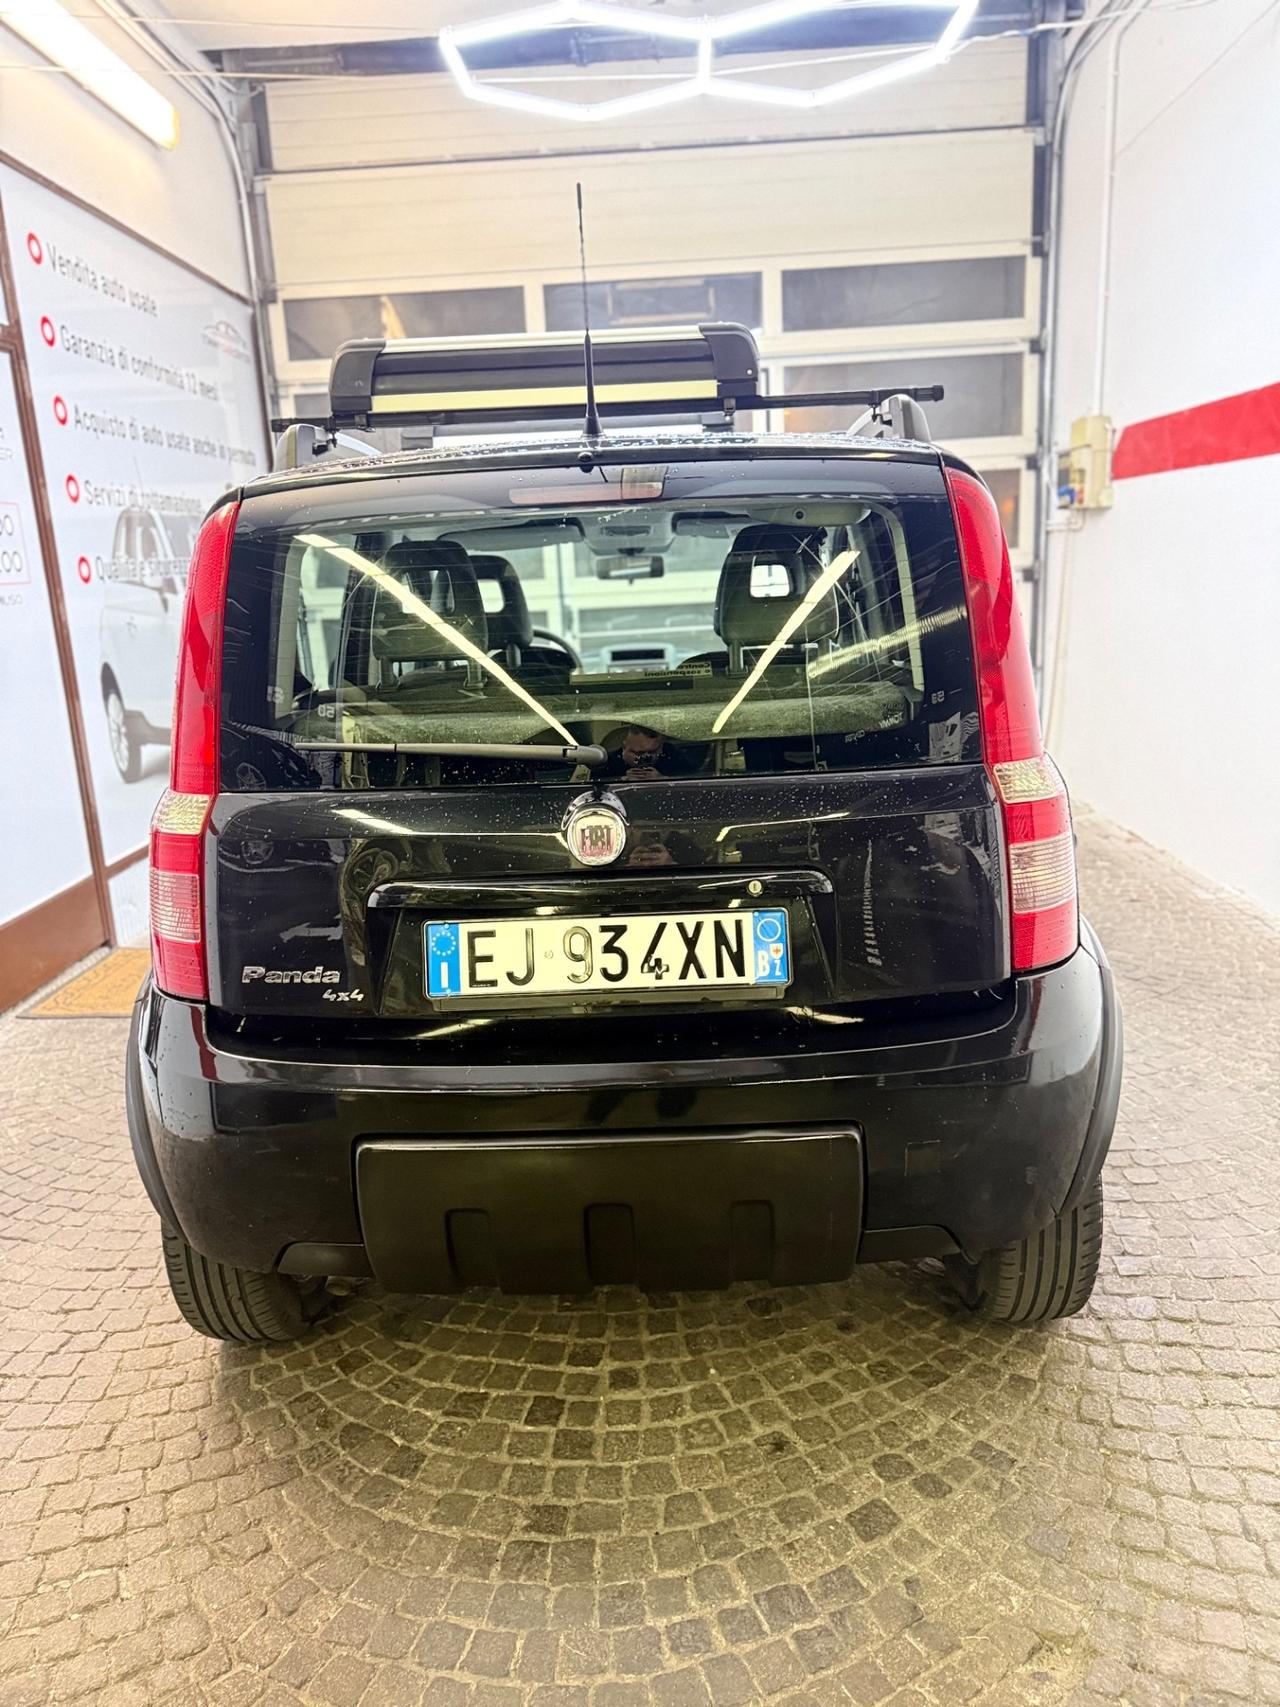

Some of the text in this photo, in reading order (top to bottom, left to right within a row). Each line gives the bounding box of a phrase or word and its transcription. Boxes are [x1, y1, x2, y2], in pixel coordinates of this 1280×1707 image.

[46, 241, 158, 318] Vendita auto usate
[60, 324, 115, 368] Garanzia
[118, 346, 129, 371] di
[185, 373, 196, 394] 12
[199, 381, 218, 401] mesi
[74, 403, 126, 439] Acquisto
[129, 412, 139, 440] di
[141, 421, 164, 446] auto
[166, 430, 191, 452] usate
[192, 433, 217, 457] anche
[84, 480, 123, 506] Servizi
[127, 485, 138, 508] di
[581, 825, 613, 857] FIAT
[241, 966, 340, 983] Panda
[322, 989, 364, 1002] 4x4
